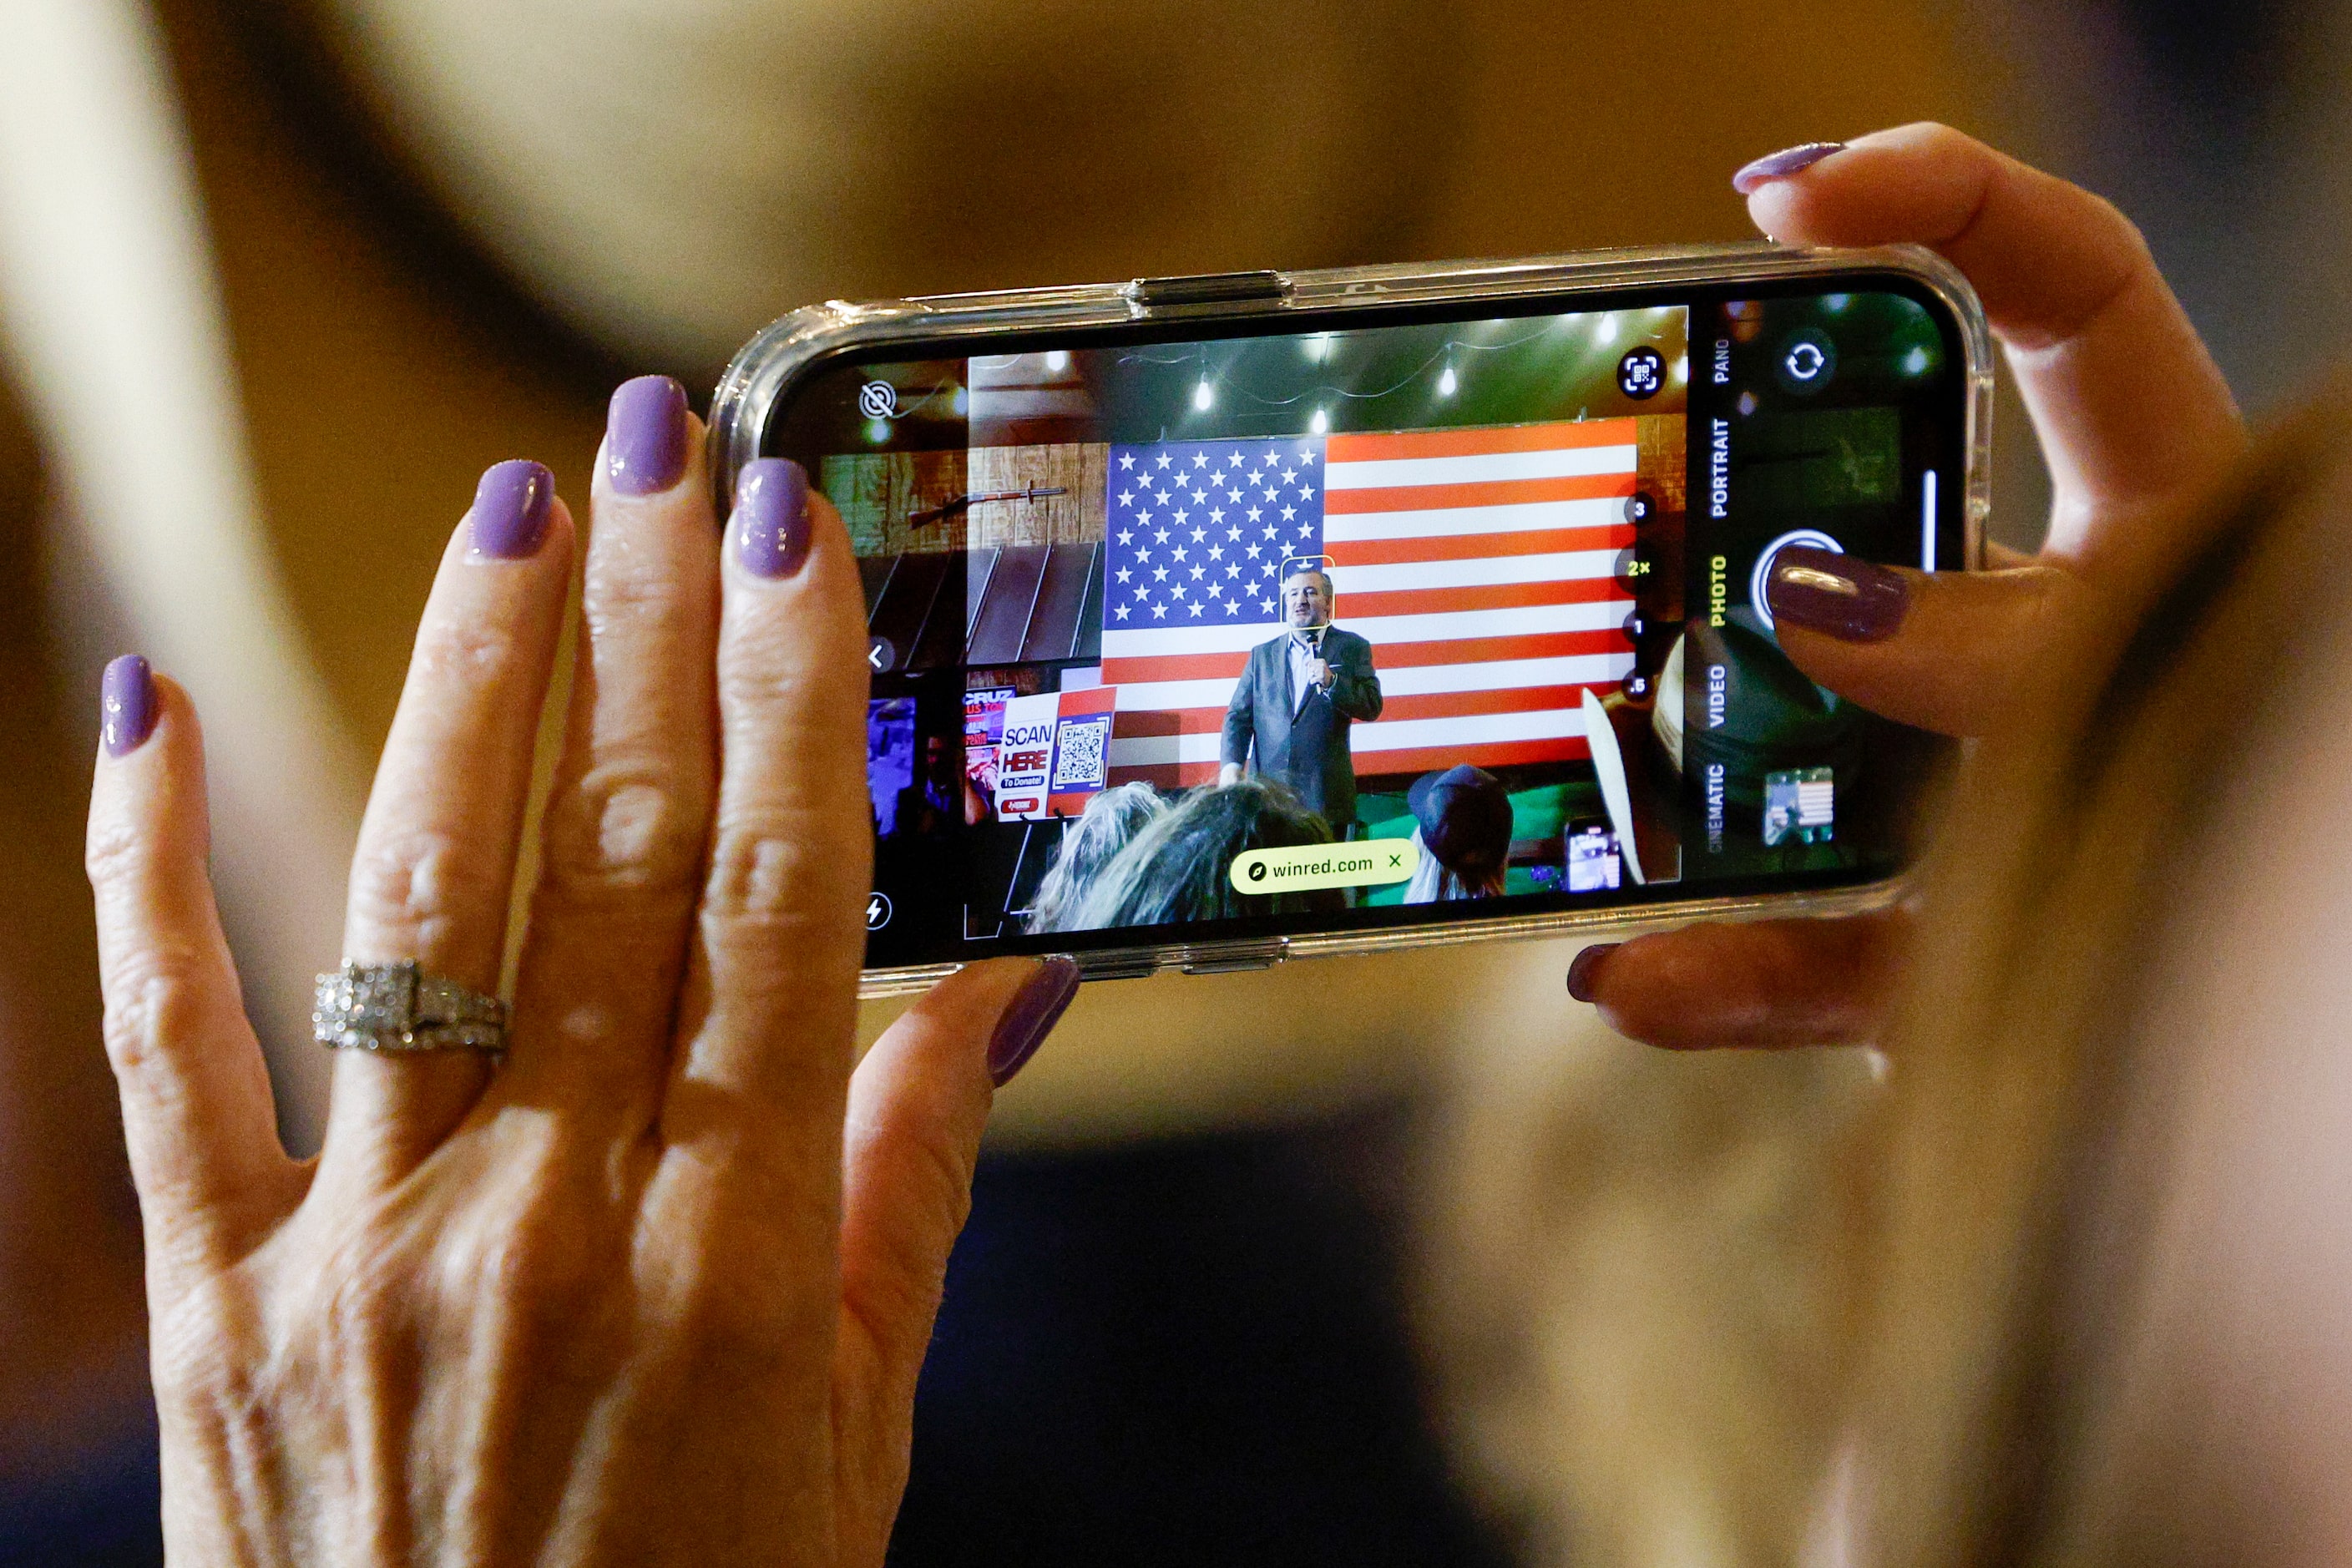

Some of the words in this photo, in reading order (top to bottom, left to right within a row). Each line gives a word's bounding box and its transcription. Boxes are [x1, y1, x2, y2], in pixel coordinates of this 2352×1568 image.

[1715, 339, 1729, 383] PANO
[1712, 419, 1728, 518] PORTRAIT
[1636, 503, 1645, 518] 3
[1712, 555, 1727, 626] PHOTO
[1635, 620, 1642, 634] 1
[1631, 679, 1645, 692] .5
[965, 690, 1012, 705] CRUZ
[1711, 665, 1725, 728] VIDEO
[1005, 724, 1052, 746] SCAN
[1003, 750, 1048, 773] HERE
[1004, 779, 1014, 787] To
[1015, 776, 1042, 786] Donate!
[1273, 859, 1373, 878] winred.com
